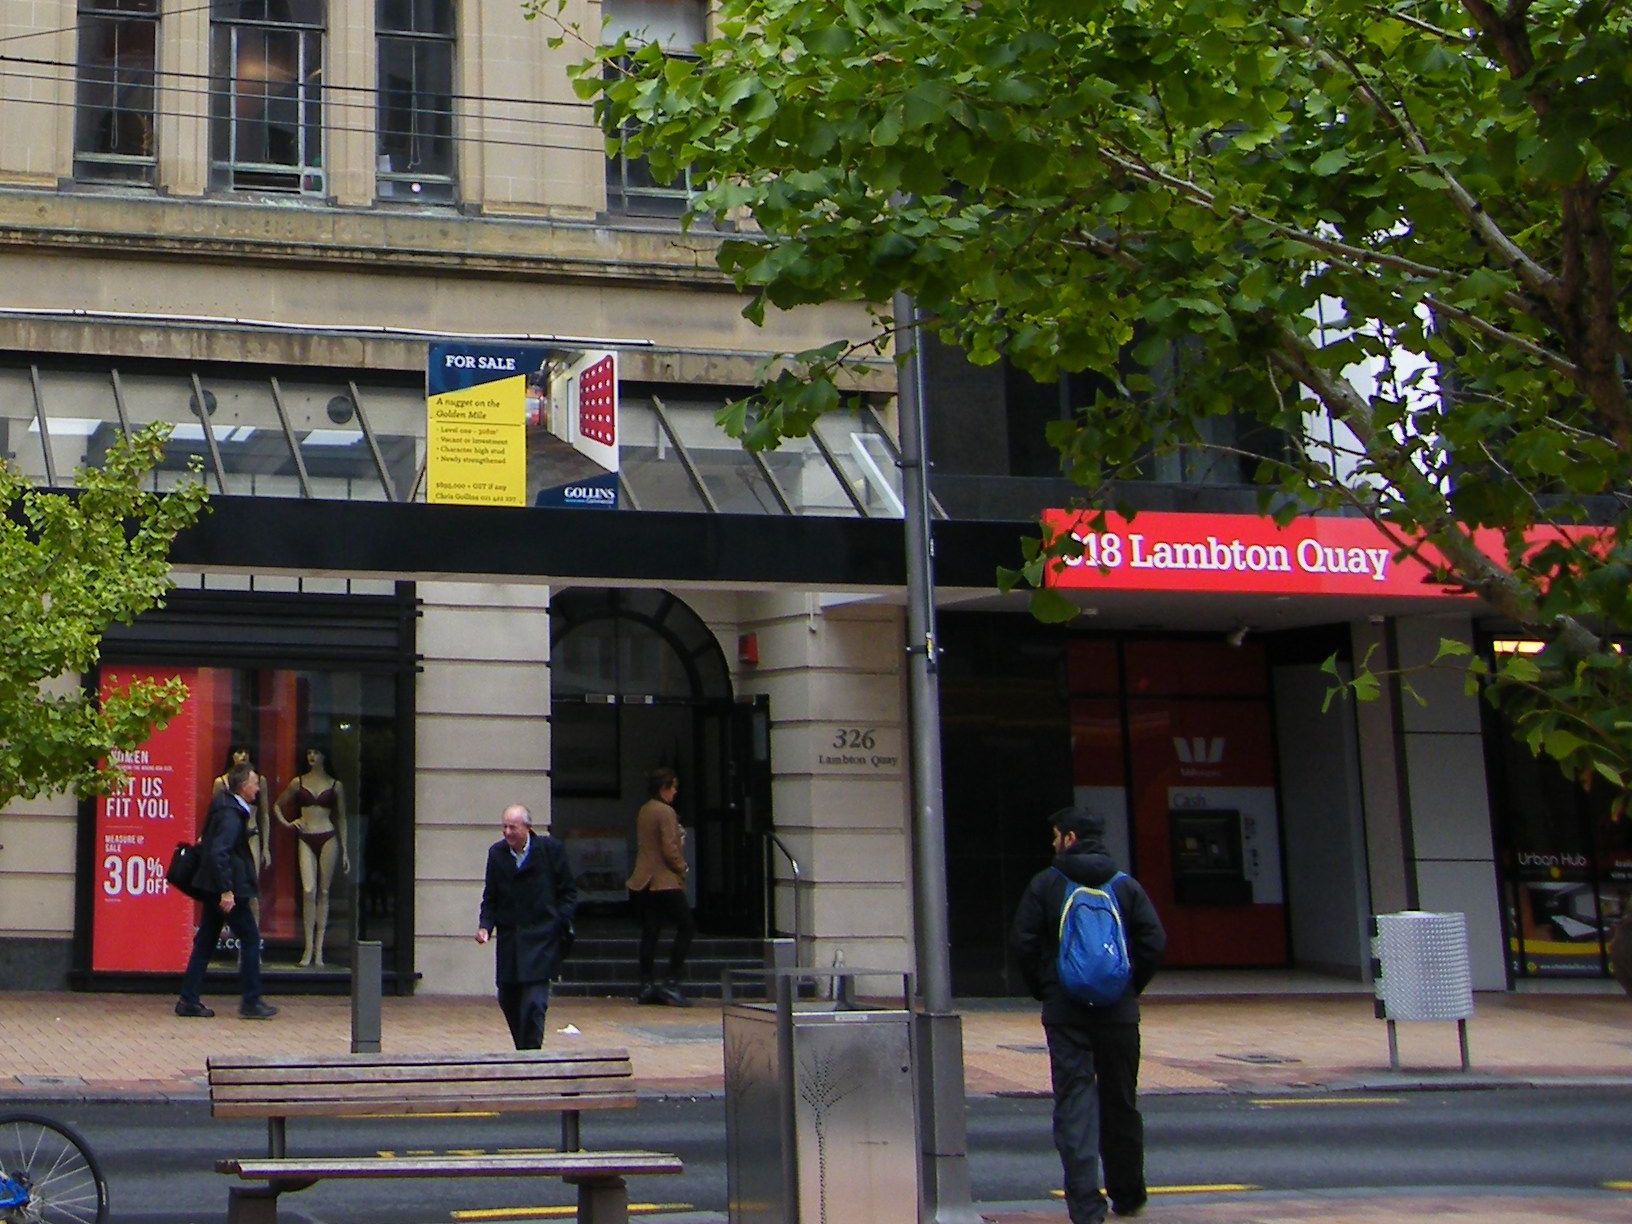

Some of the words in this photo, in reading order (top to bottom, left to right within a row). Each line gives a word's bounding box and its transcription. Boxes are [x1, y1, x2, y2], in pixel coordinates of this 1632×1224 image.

[445, 355, 476, 369] FOR
[478, 357, 516, 371] SALE
[436, 397, 443, 405] A
[445, 399, 473, 408] nugget
[487, 399, 500, 408] the
[436, 409, 466, 418] Golden
[468, 411, 487, 419] Mile
[472, 437, 508, 445] investment
[440, 445, 472, 453] Character
[474, 447, 489, 455] high
[440, 455, 461, 463] Newly
[462, 457, 506, 465] strengthened
[564, 486, 616, 498] GOLLINS
[1128, 534, 1291, 572] Lambton
[1296, 538, 1390, 581] Quay
[833, 728, 876, 750] 326
[818, 754, 867, 764] Lambton
[870, 754, 898, 768] Quay
[141, 777, 163, 796] US
[106, 798, 131, 817] FIT
[136, 798, 174, 818] YOU.
[1173, 792, 1207, 809] Cash
[1517, 851, 1559, 866] Urban
[1560, 853, 1587, 866] Hub
[104, 855, 164, 895] 30%
[146, 878, 169, 895] OFF
